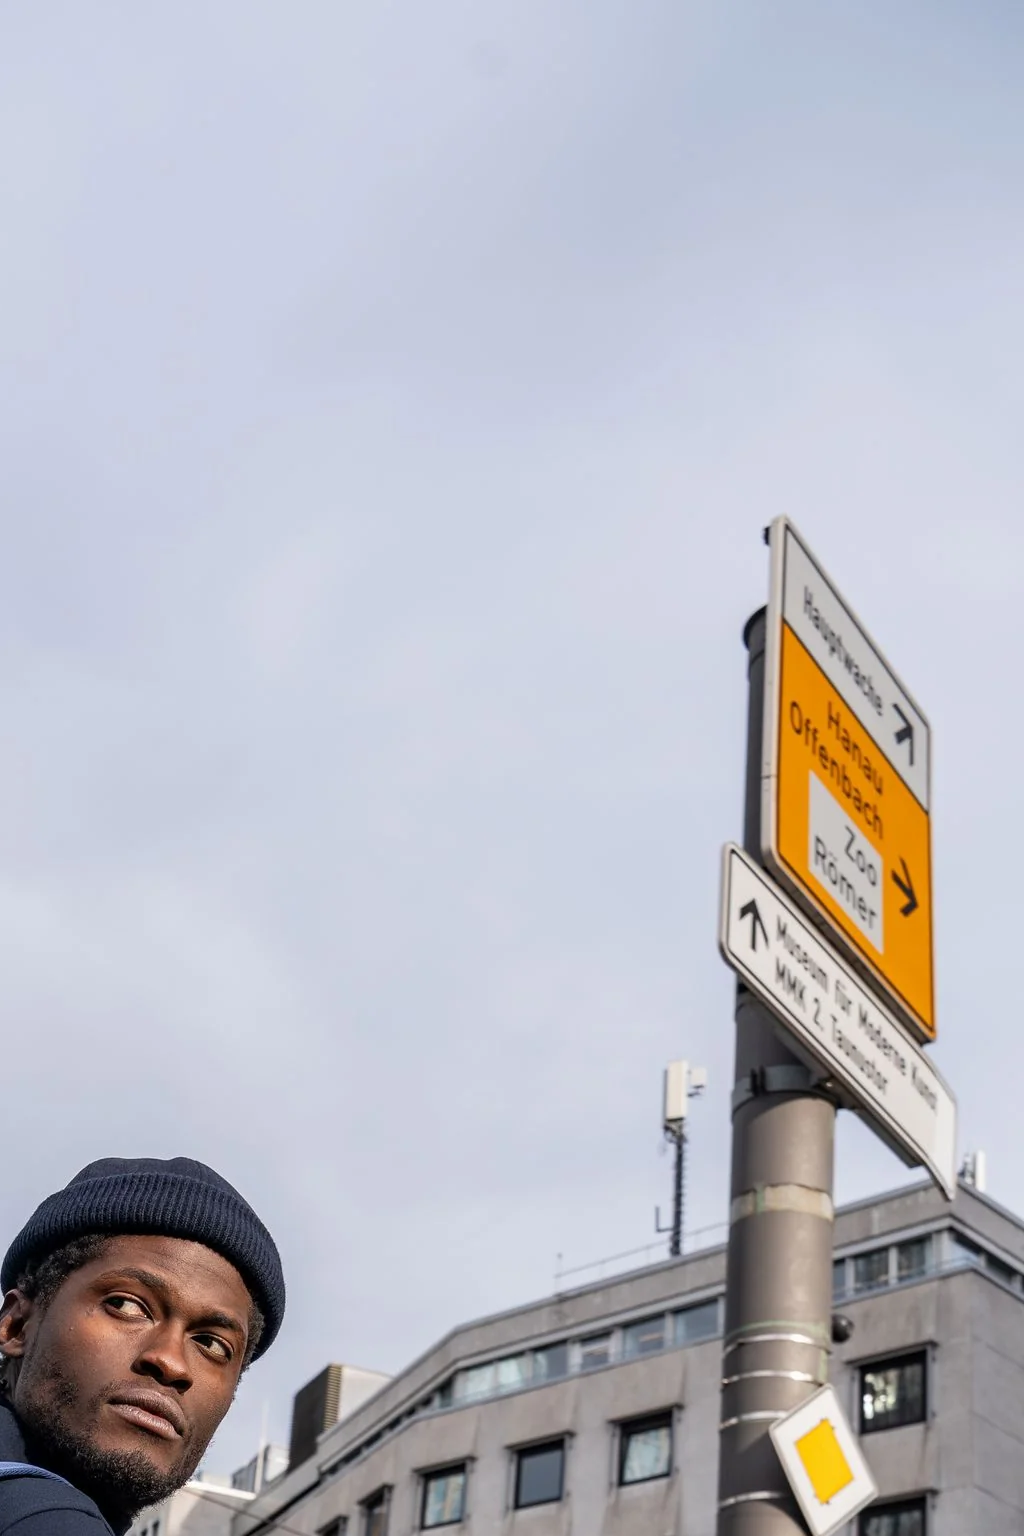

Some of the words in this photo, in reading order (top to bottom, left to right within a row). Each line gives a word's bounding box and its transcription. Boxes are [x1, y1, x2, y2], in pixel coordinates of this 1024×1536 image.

[803, 584, 884, 717] Hauptwache
[789, 700, 884, 840] Offenbach
[827, 700, 884, 796] Hanau
[813, 834, 878, 931] Römer
[843, 824, 878, 888] Zoo
[775, 955, 807, 1013] MMK
[775, 914, 829, 995] Museum
[858, 1002, 907, 1078] Moderne
